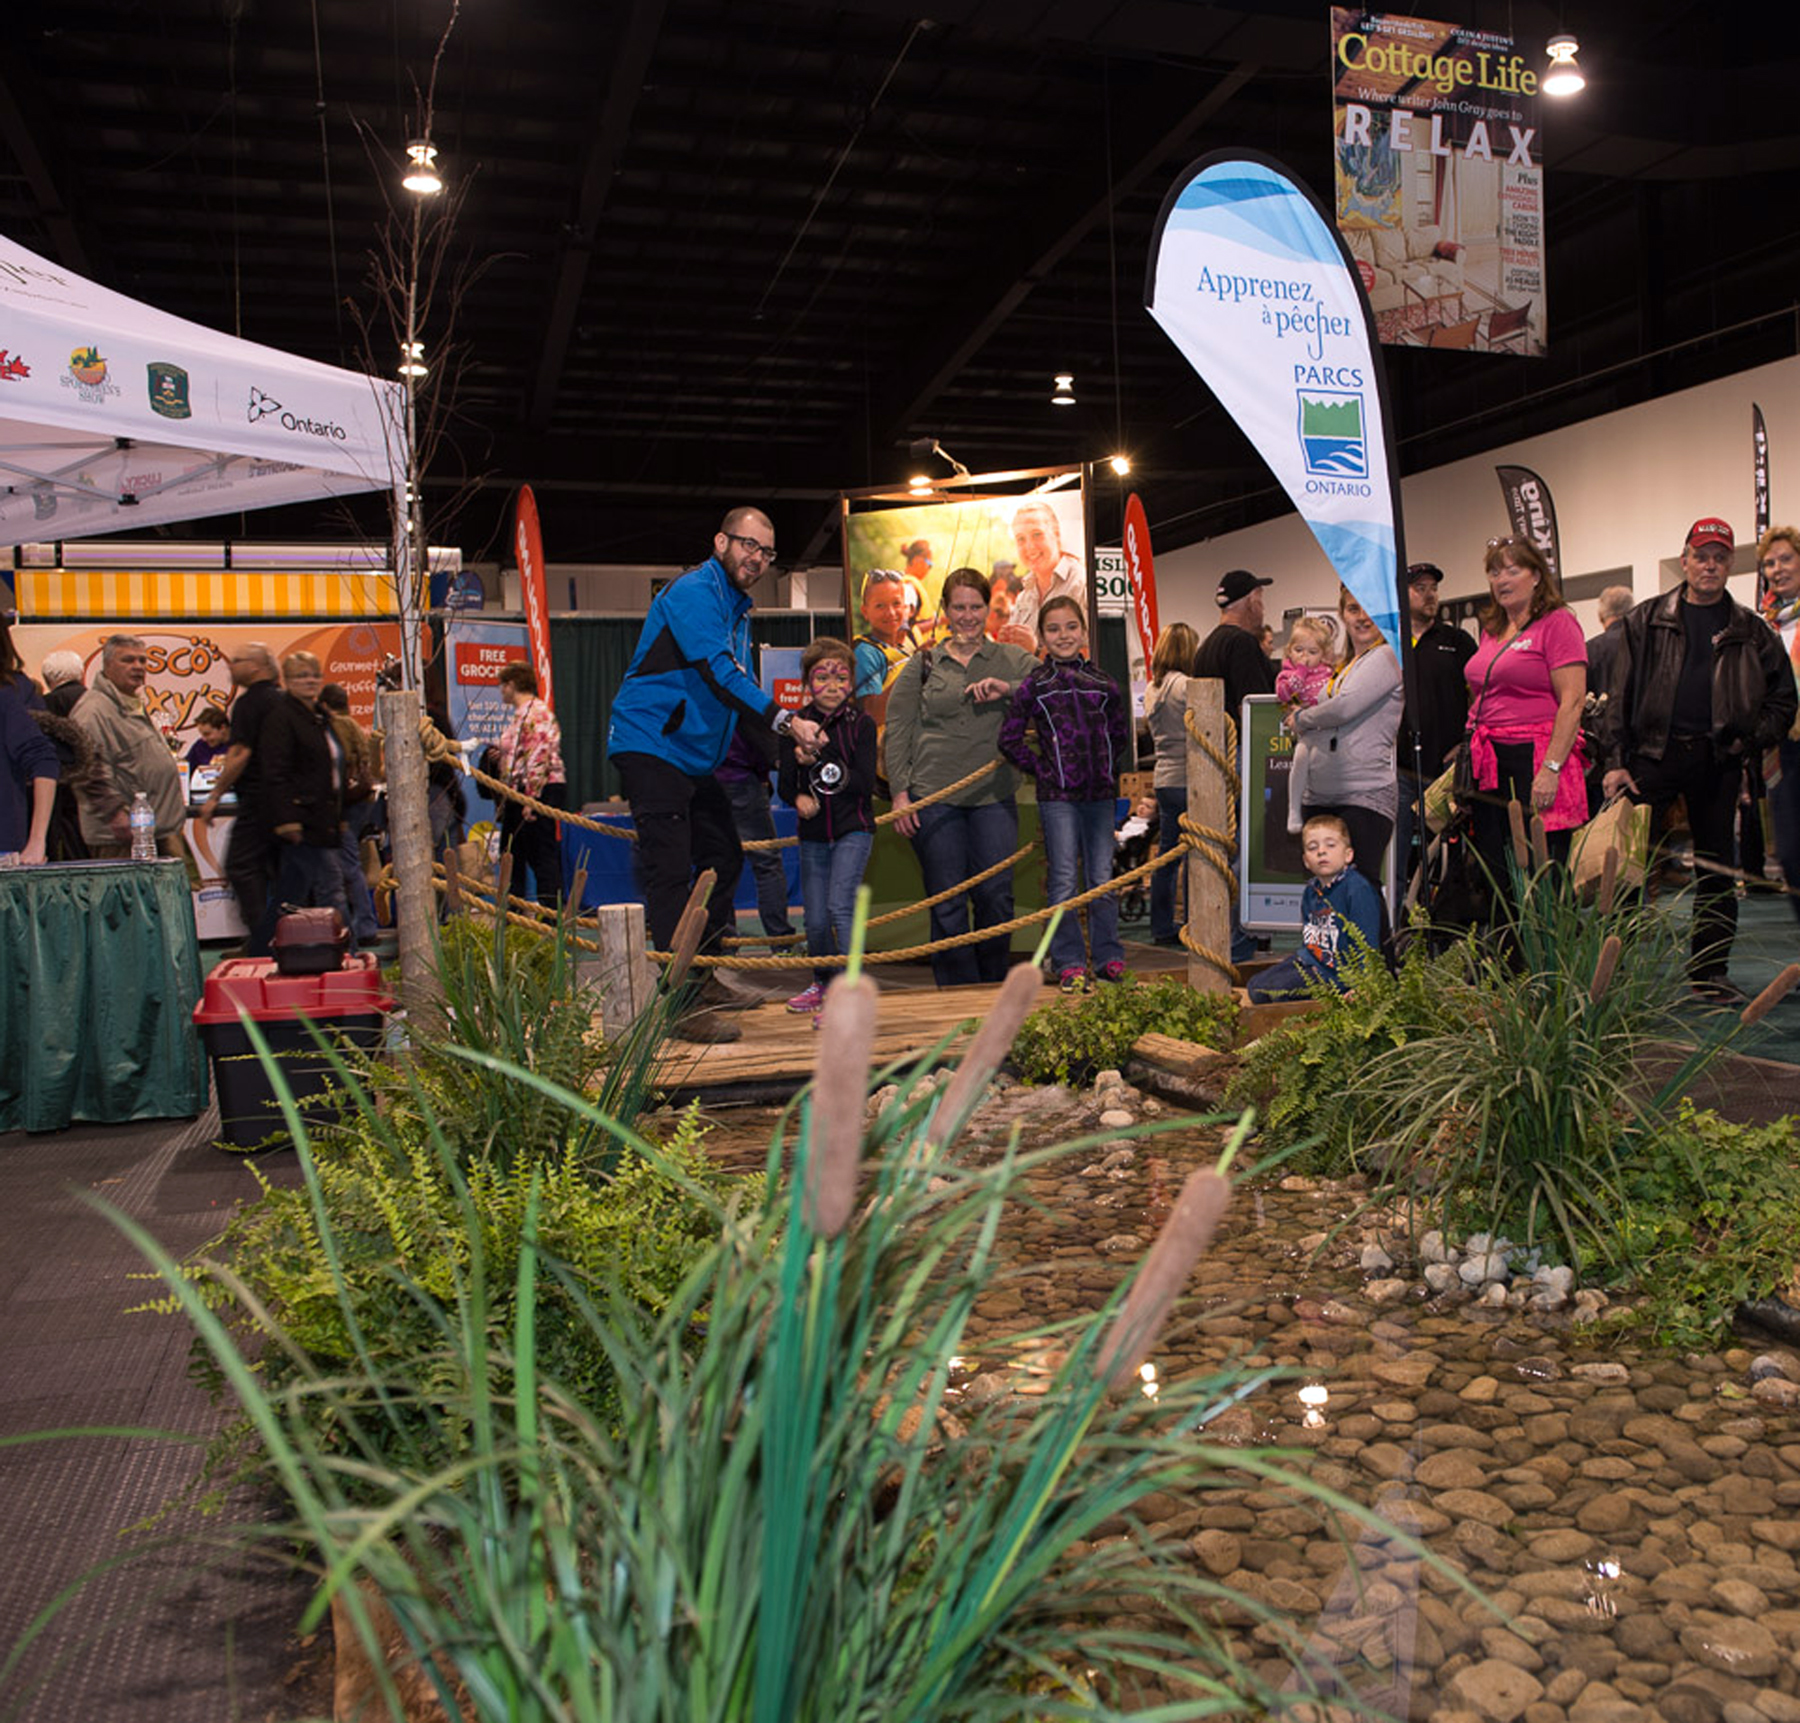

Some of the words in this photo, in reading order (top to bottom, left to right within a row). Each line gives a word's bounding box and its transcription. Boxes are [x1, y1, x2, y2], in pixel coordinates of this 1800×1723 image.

[1338, 33, 1473, 93] Cottage
[1476, 52, 1537, 96] Life
[1357, 87, 1396, 104] Where
[1397, 93, 1431, 108] writer
[1430, 97, 1458, 113] John
[1458, 102, 1487, 119] Gray
[1486, 108, 1511, 120] goes
[1512, 110, 1523, 122] to
[1343, 103, 1536, 168] RELAX
[1517, 172, 1538, 185] Plus
[1197, 265, 1314, 303] Apprenez
[1262, 304, 1272, 325] à
[1276, 301, 1351, 361] pêcher
[1294, 365, 1364, 387] PARCS
[281, 412, 346, 440] Ontario
[1305, 479, 1372, 497] ONTARIO
[1095, 557, 1126, 571] ISL
[480, 649, 507, 663] FREE
[330, 659, 380, 673] Gourmet
[460, 663, 507, 678] GROC
[784, 682, 804, 692] Red
[779, 693, 799, 703] free
[1269, 759, 1295, 770] Lear
